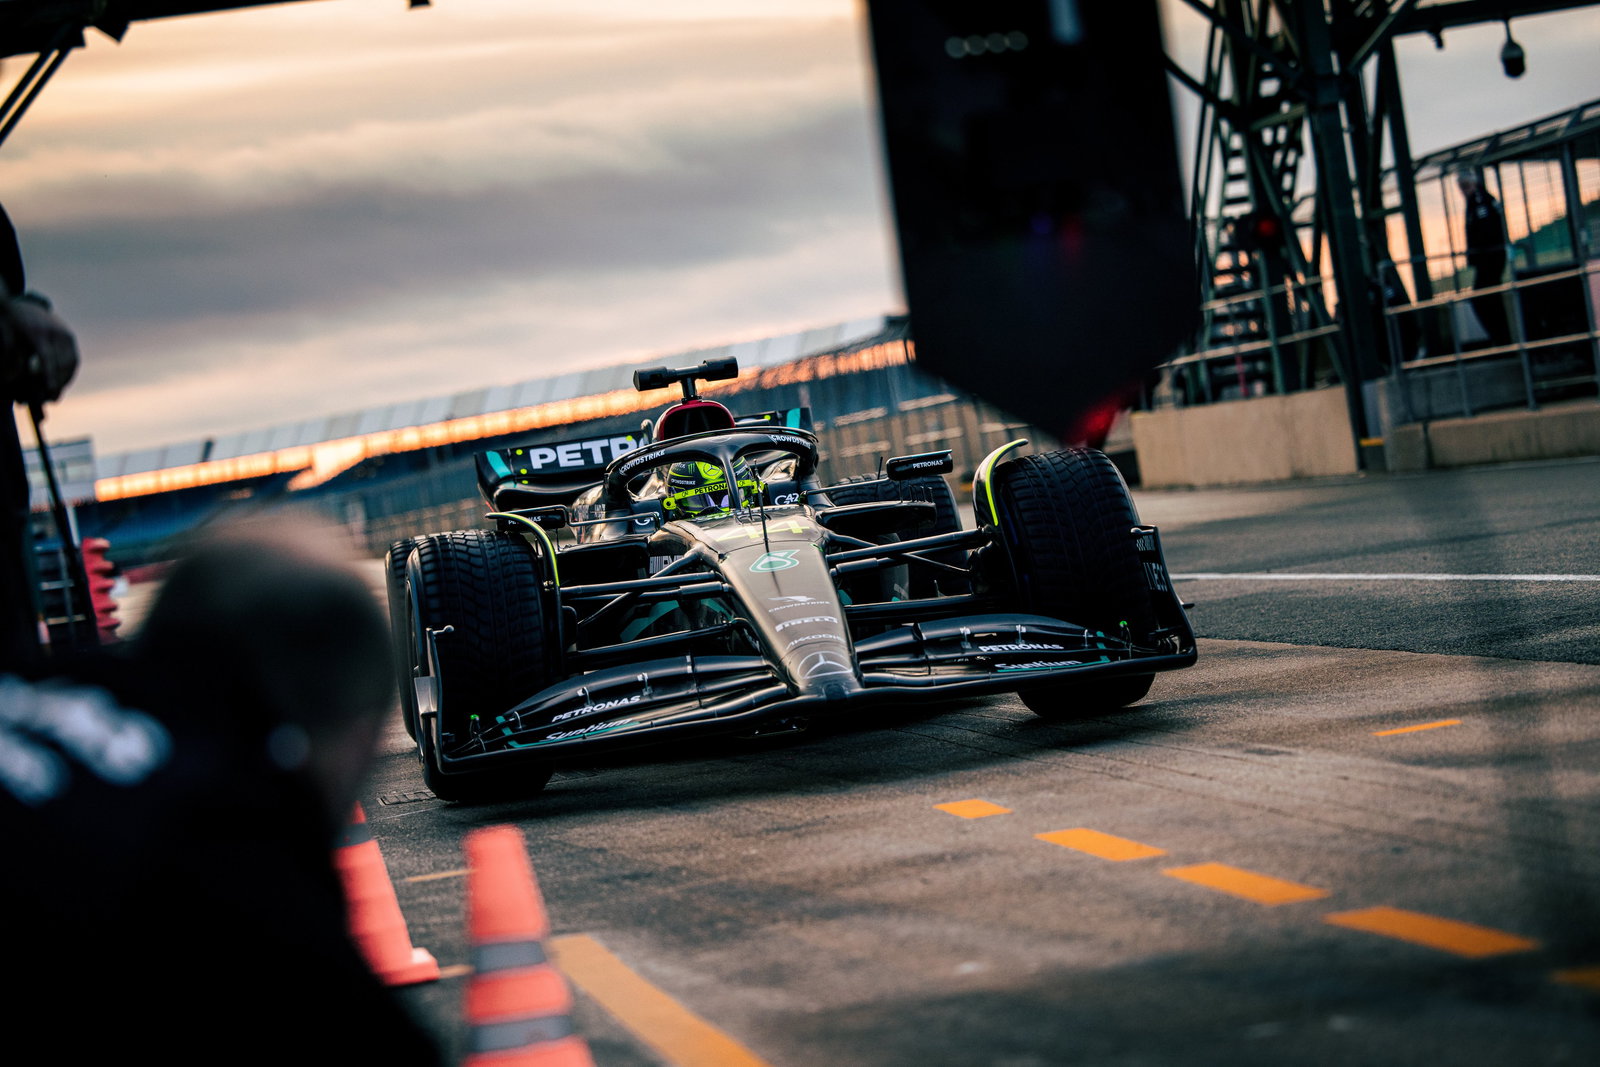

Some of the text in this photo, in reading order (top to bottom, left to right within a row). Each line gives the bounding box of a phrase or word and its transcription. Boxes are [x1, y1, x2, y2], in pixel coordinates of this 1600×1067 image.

[619, 449, 666, 474] CROWDSTRIKE
[912, 459, 944, 469] PETRONAS
[978, 643, 1065, 653] PETRONAS
[550, 695, 642, 723] PETRONAS
